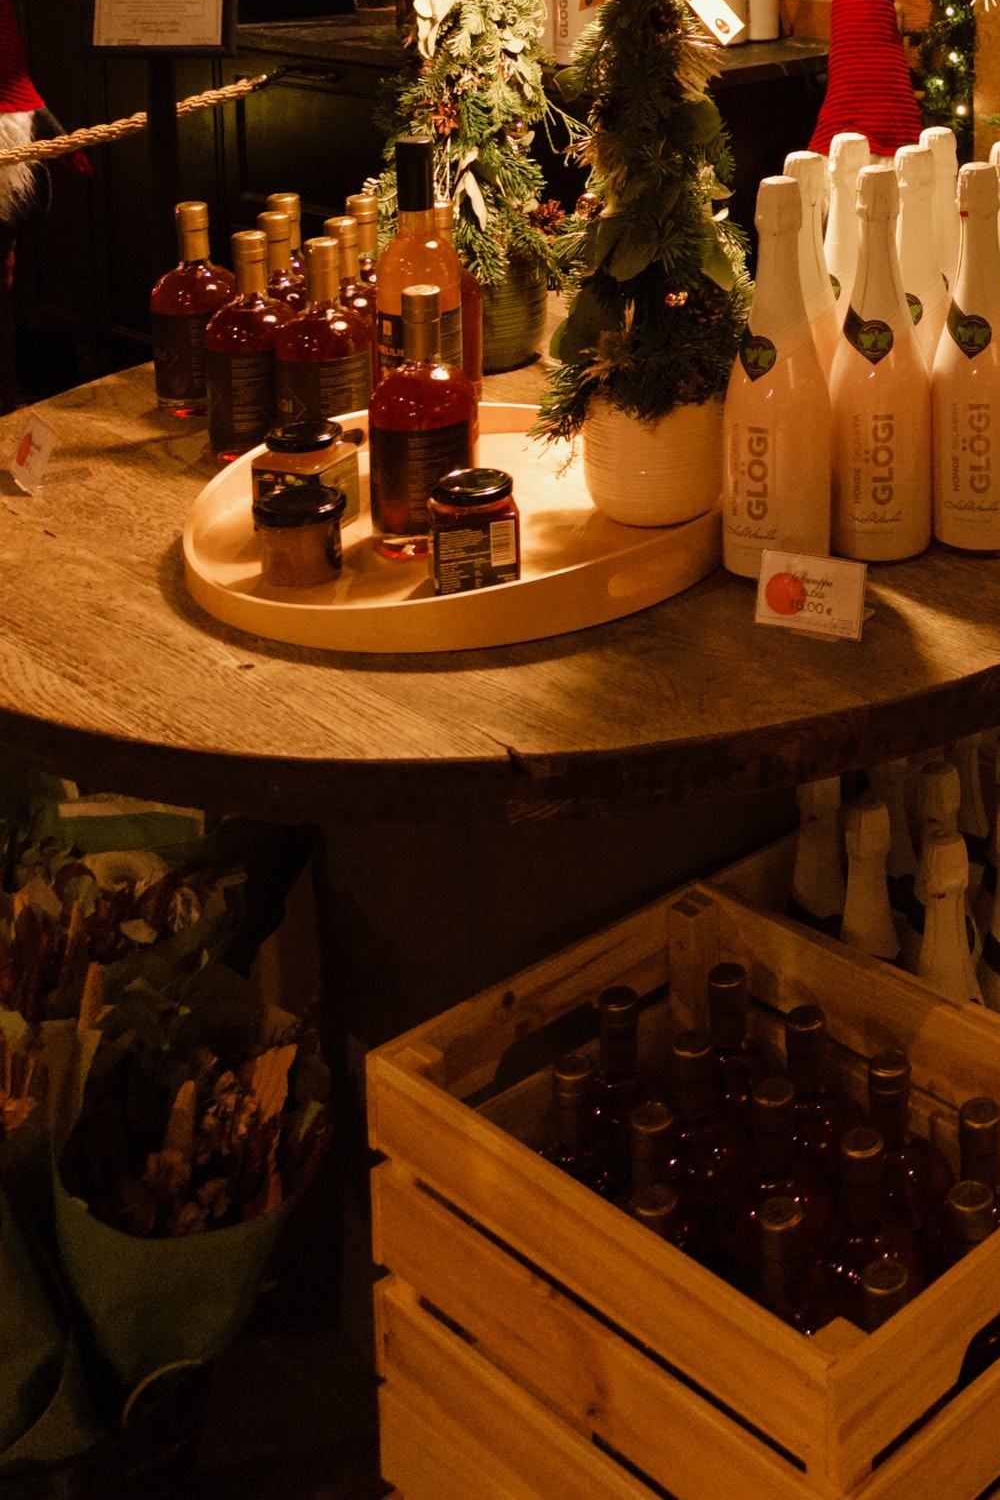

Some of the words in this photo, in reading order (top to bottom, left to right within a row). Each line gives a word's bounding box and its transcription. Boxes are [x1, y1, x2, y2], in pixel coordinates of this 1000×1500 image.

[741, 425, 770, 521] GLÖGI
[863, 413, 894, 506] GLÖGI
[961, 403, 992, 495] GLÖGI
